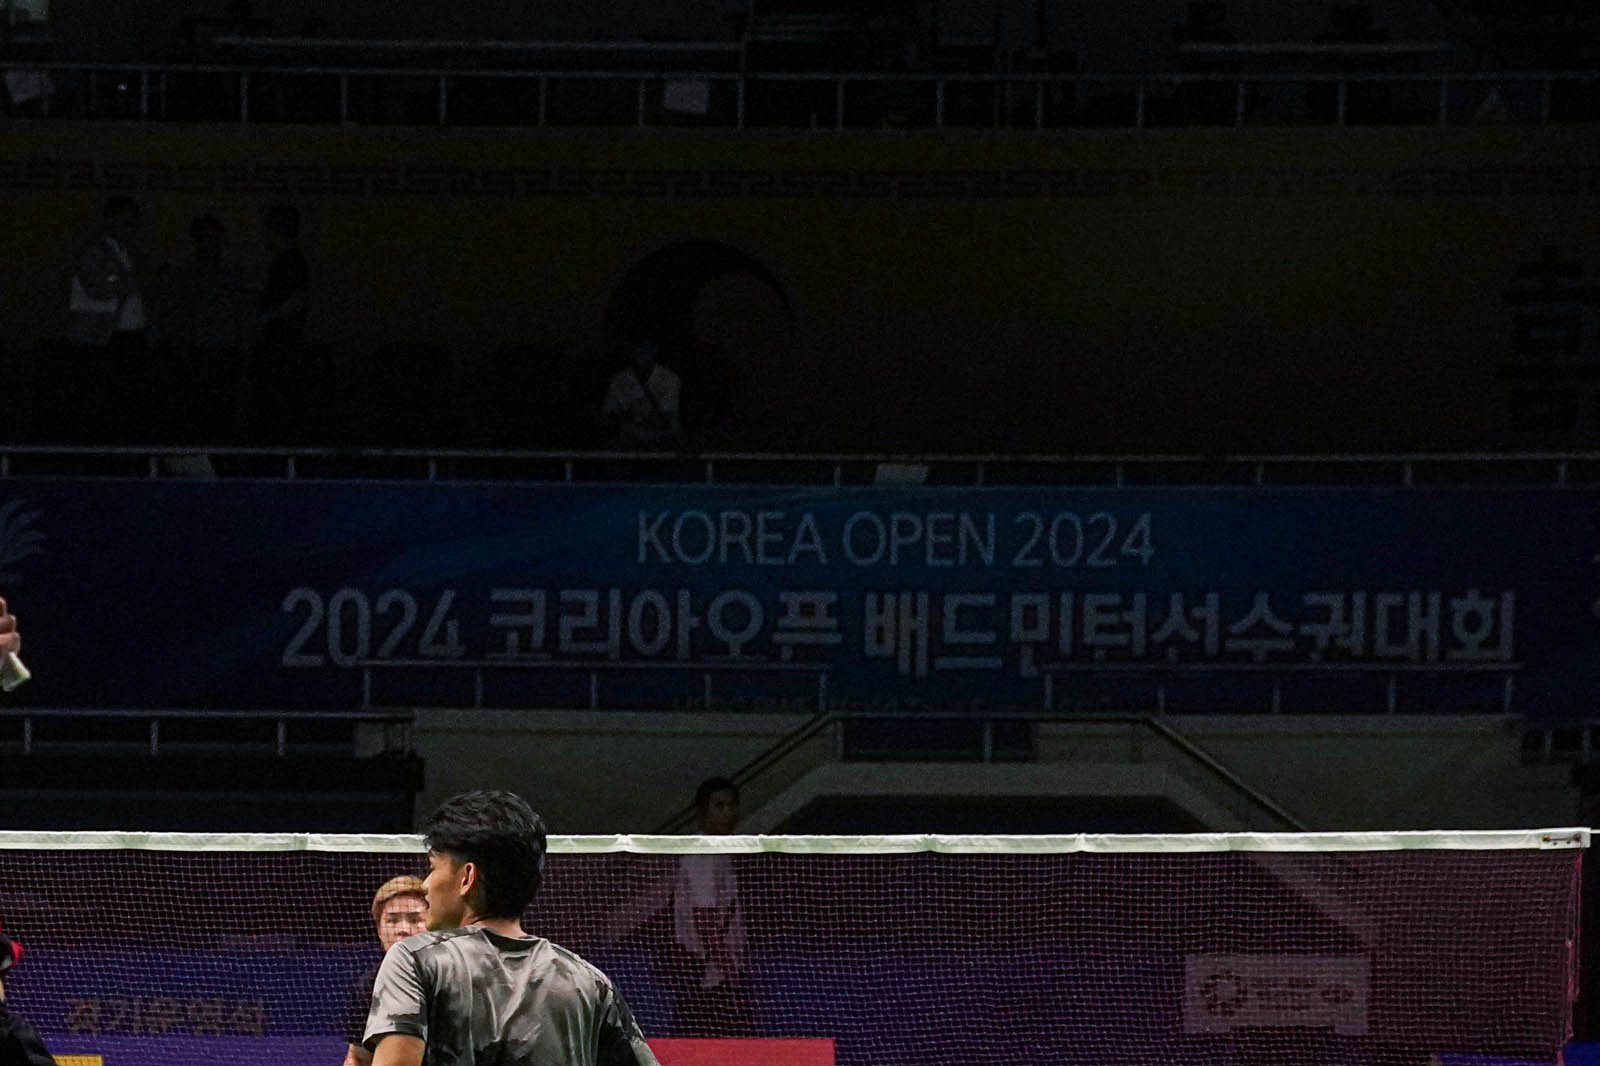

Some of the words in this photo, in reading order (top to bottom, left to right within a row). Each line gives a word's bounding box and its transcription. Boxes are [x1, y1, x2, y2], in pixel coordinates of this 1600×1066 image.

[636, 509, 828, 566] KOREA
[841, 509, 997, 567] OPEN
[1011, 511, 1155, 568] 2024
[280, 586, 464, 667] 2024
